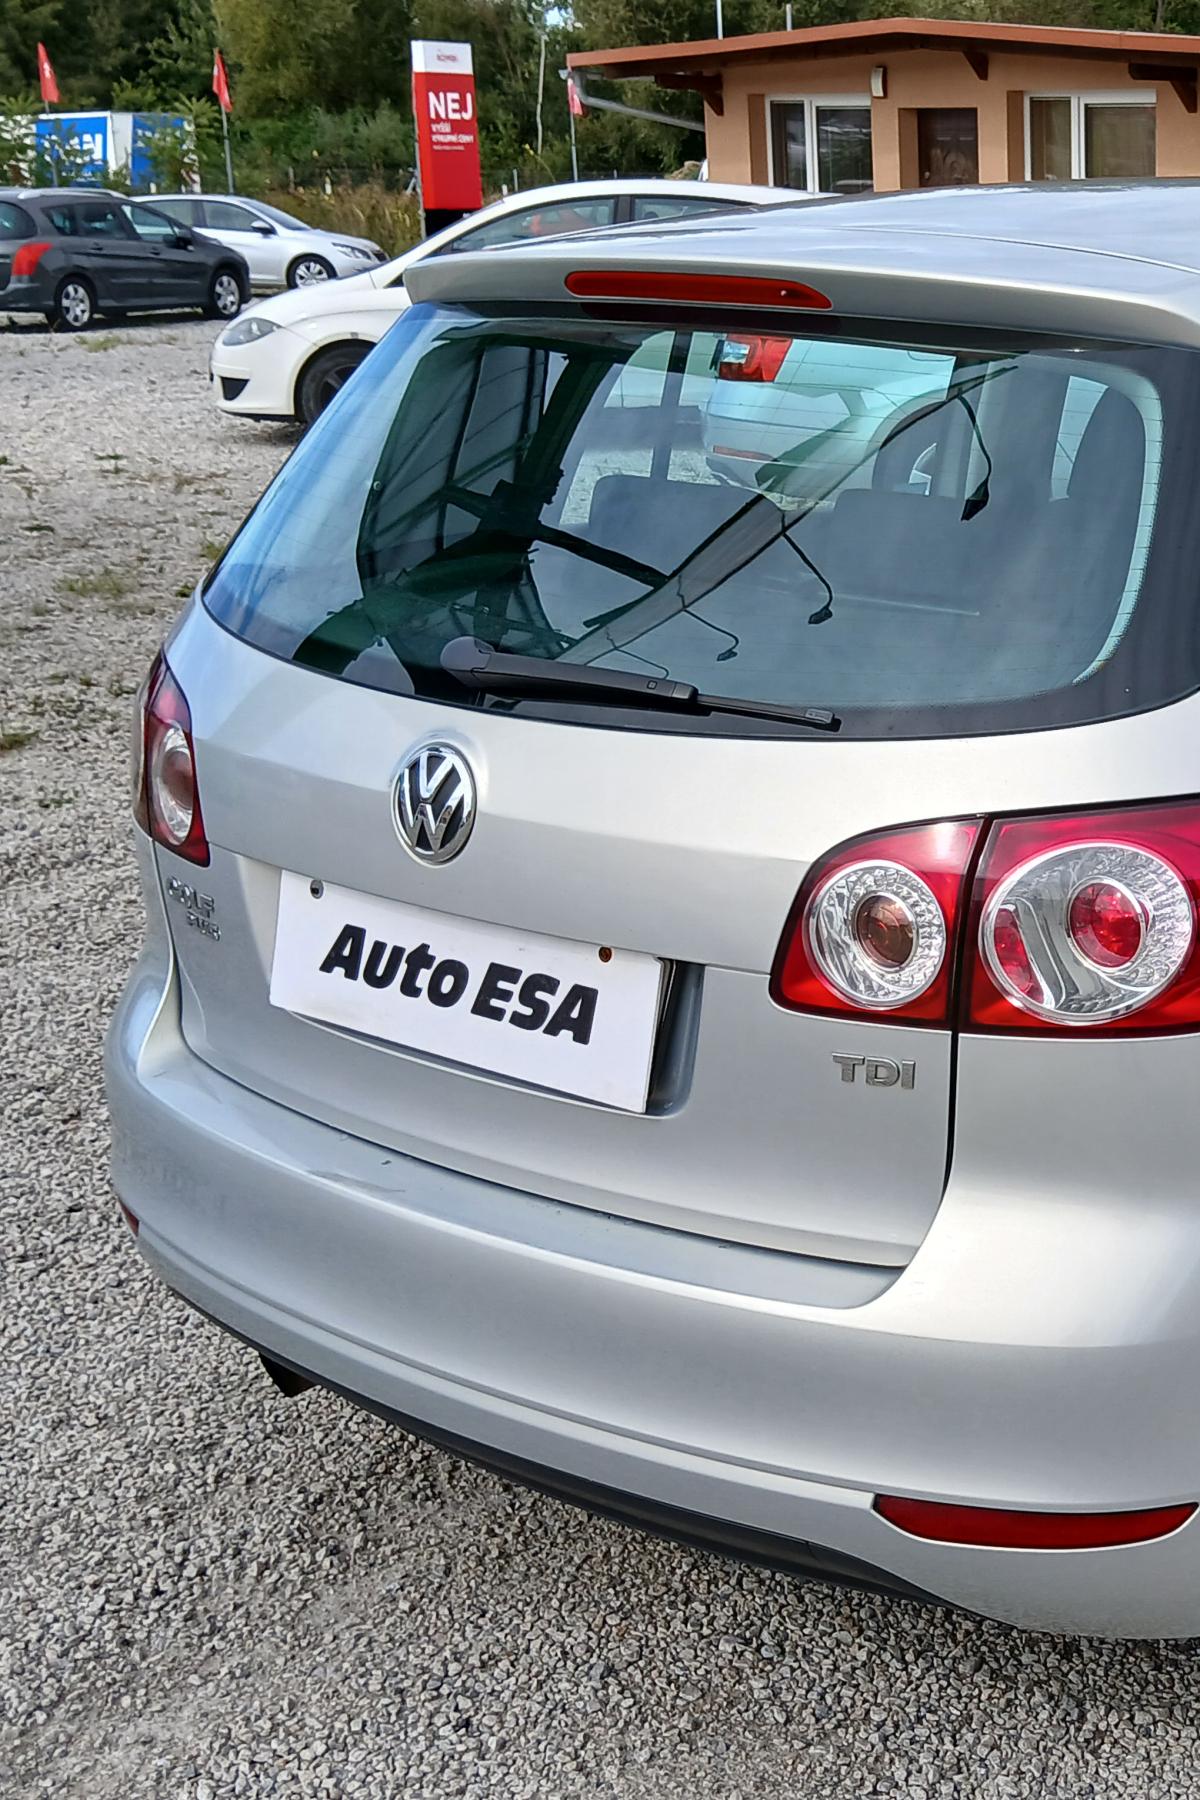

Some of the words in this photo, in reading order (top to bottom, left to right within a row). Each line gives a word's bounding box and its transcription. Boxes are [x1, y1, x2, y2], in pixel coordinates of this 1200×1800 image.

[427, 91, 474, 120] NEJ
[319, 923, 469, 1008] Auto
[470, 962, 599, 1046] ESA
[831, 1052, 916, 1090] TDI
